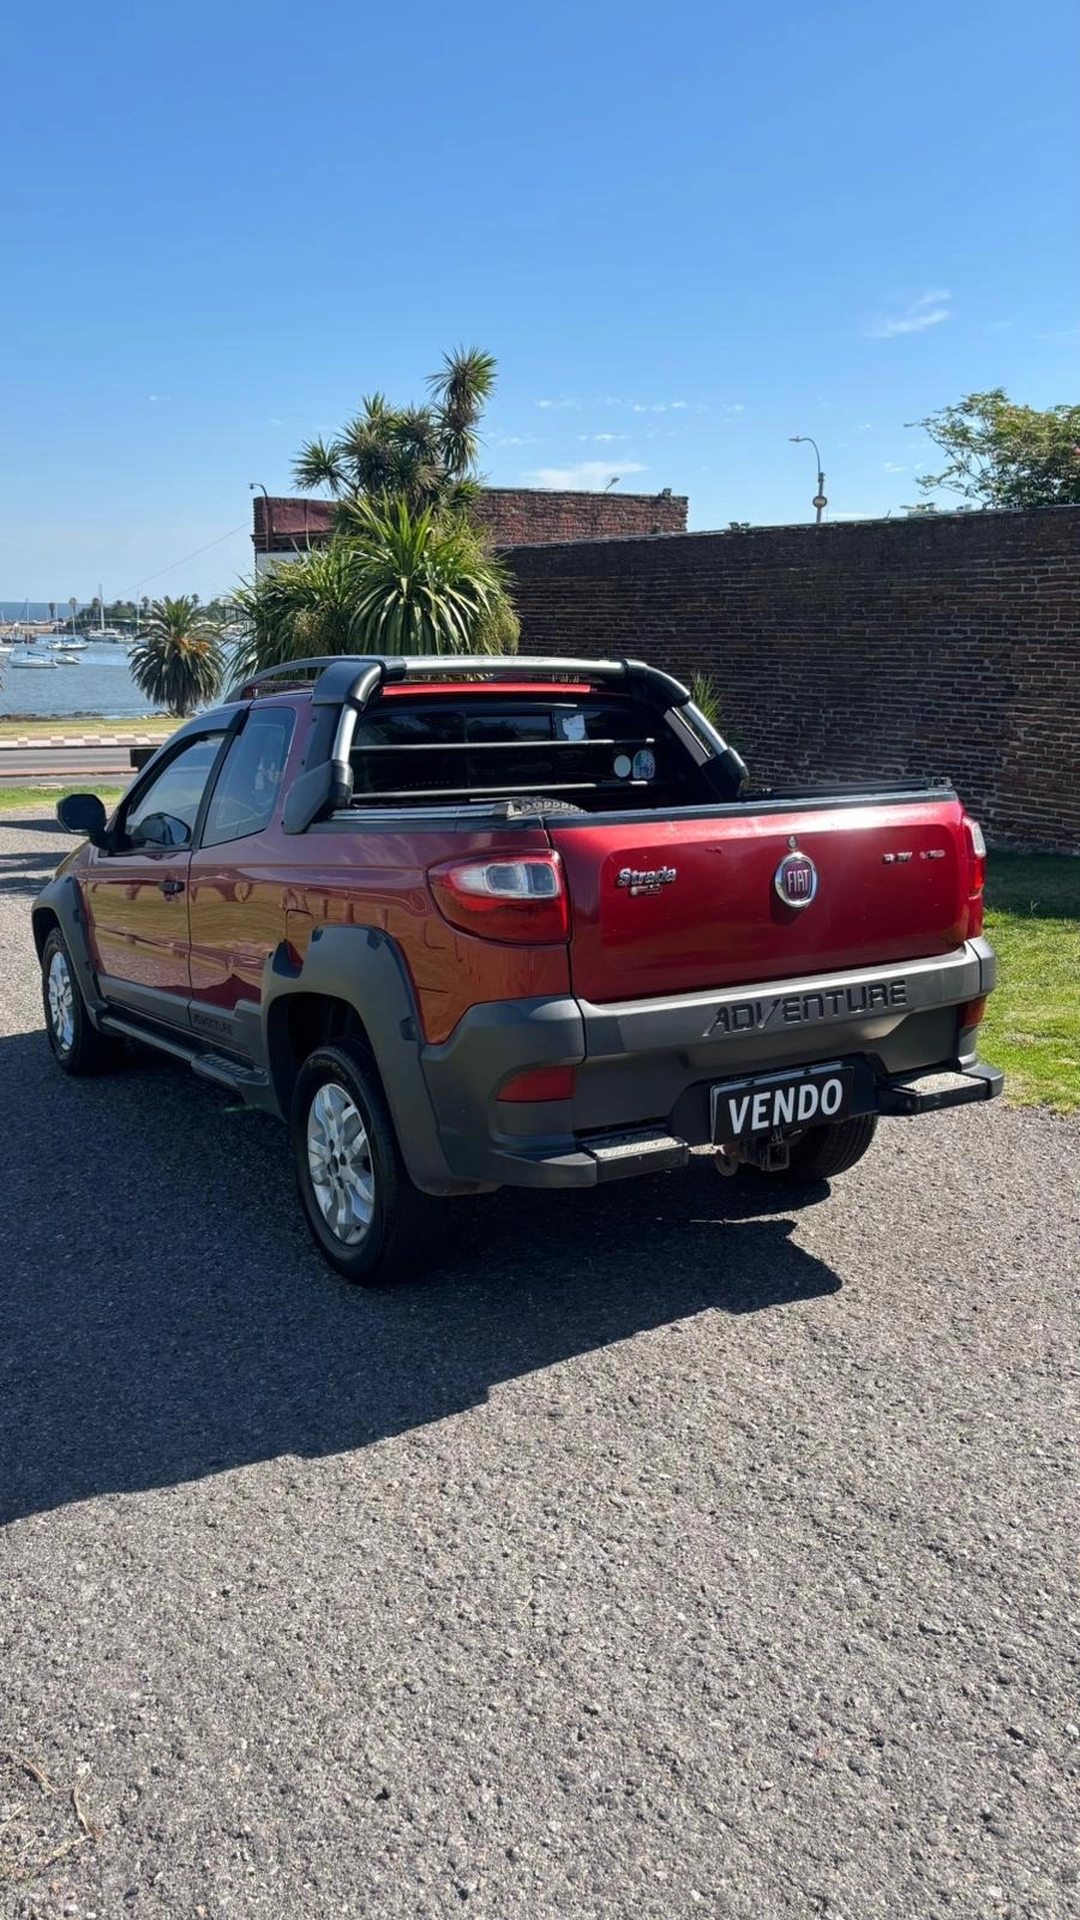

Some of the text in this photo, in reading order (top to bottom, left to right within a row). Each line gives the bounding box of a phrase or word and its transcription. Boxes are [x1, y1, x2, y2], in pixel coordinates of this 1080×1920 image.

[618, 866, 676, 886] Strada
[787, 869, 809, 893] FIAT
[702, 979, 907, 1037] ADVENTURE
[728, 1078, 843, 1134] VENDO
